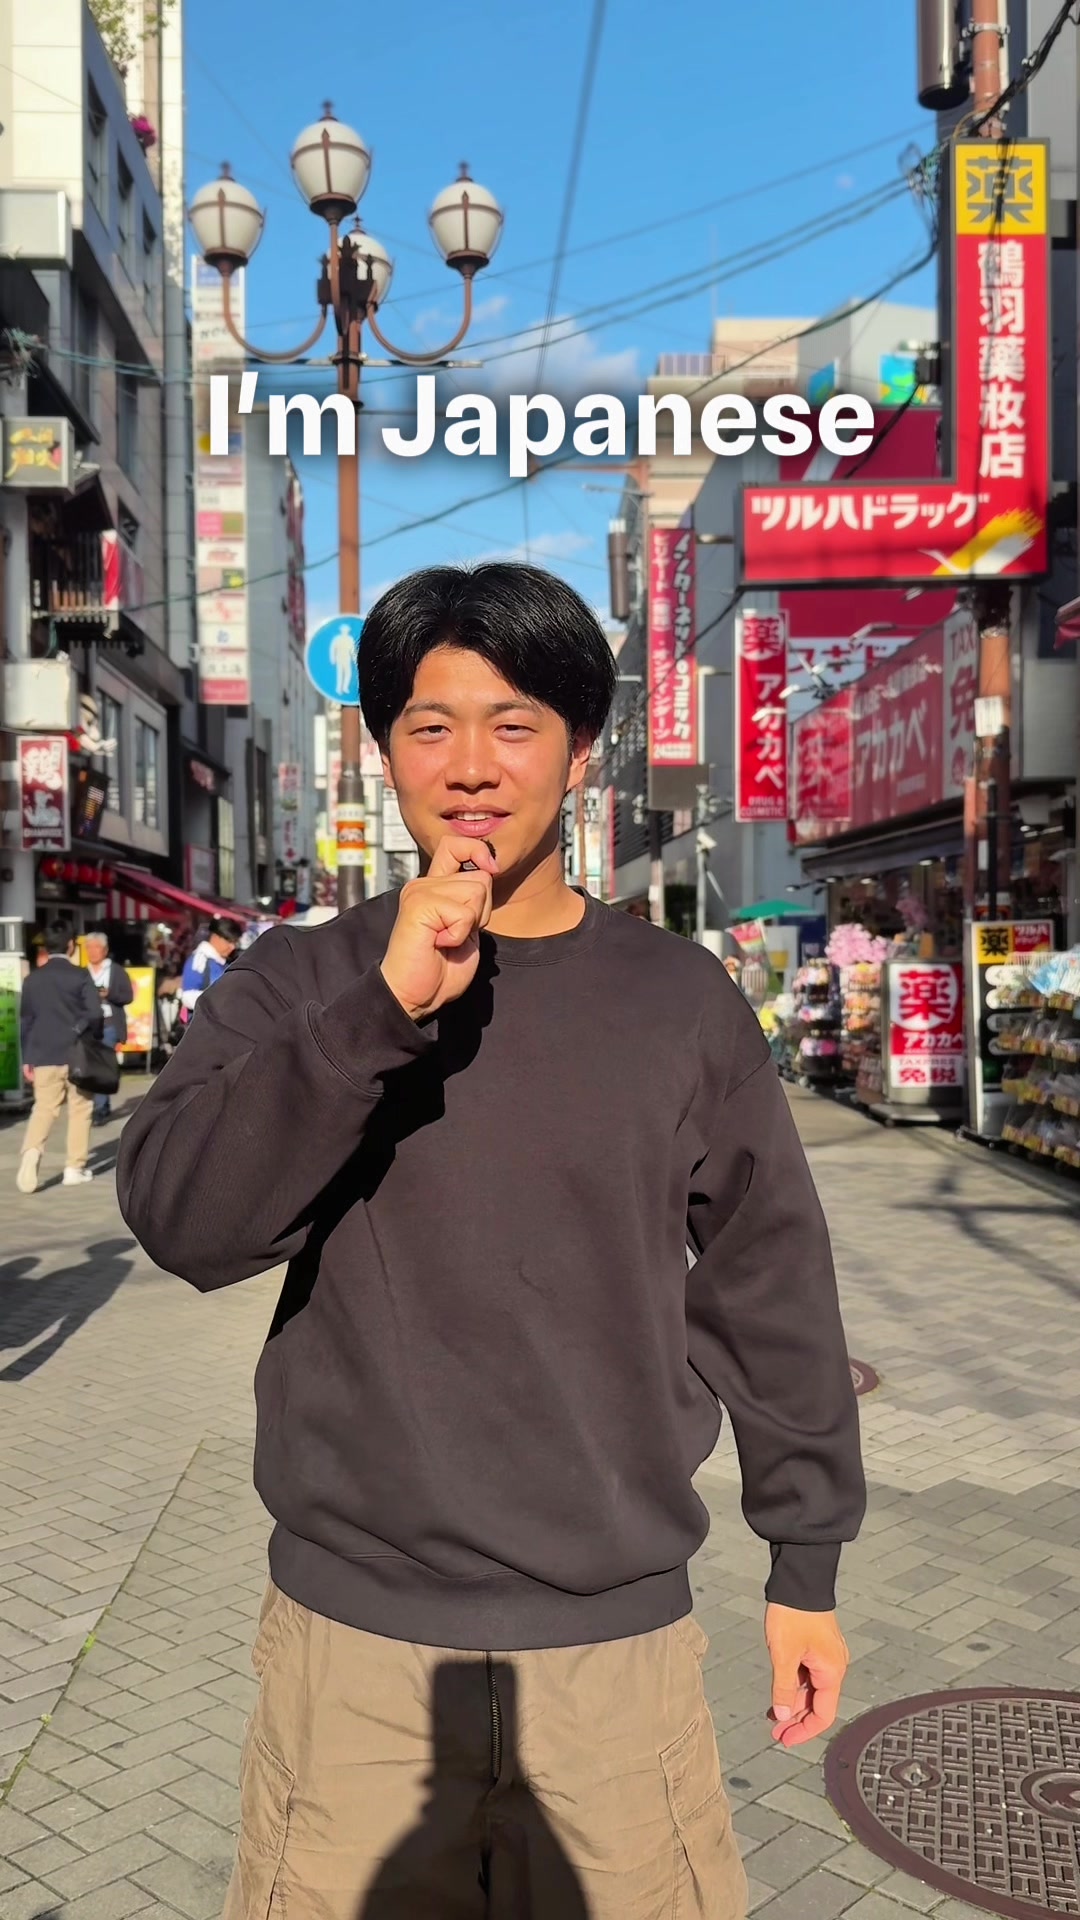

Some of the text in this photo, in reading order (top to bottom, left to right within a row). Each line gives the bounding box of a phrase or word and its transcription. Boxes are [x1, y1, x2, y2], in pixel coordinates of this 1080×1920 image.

[966, 156, 1034, 224] 薬
[751, 491, 992, 531] ツルハドラッグ
[744, 615, 782, 655] 薬
[754, 672, 784, 790] アカカベ
[856, 698, 928, 787] アカカベ
[741, 807, 784, 817] COSMETIC
[748, 796, 774, 806] DRUG
[981, 927, 1009, 956] 薬
[898, 968, 953, 1022] 薬
[898, 1067, 957, 1084] 免税
